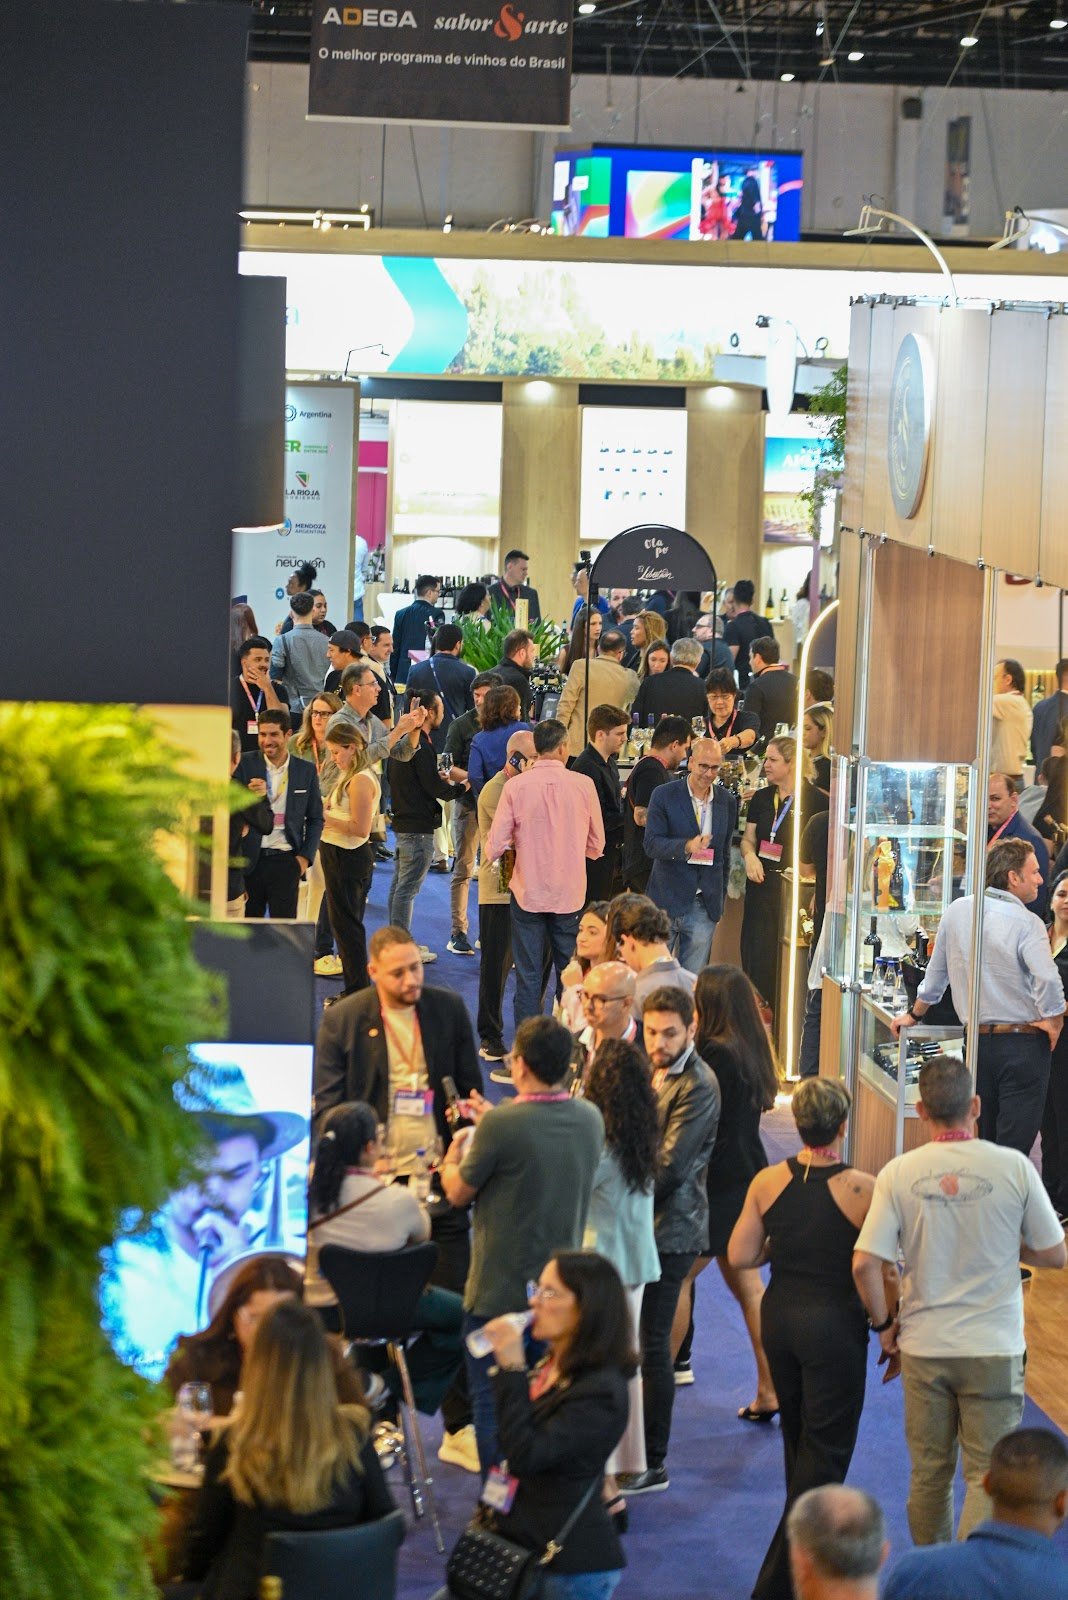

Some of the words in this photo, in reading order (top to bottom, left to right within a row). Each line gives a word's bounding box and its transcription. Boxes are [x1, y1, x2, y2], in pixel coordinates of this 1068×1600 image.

[322, 7, 417, 29] ADEGA
[318, 47, 329, 59] O
[332, 48, 377, 61] melhor
[379, 51, 442, 66] programa
[445, 52, 461, 65] de
[464, 53, 507, 67] vinhos
[509, 55, 527, 68] do
[529, 56, 566, 69] Brasil
[299, 411, 332, 419] Argentina
